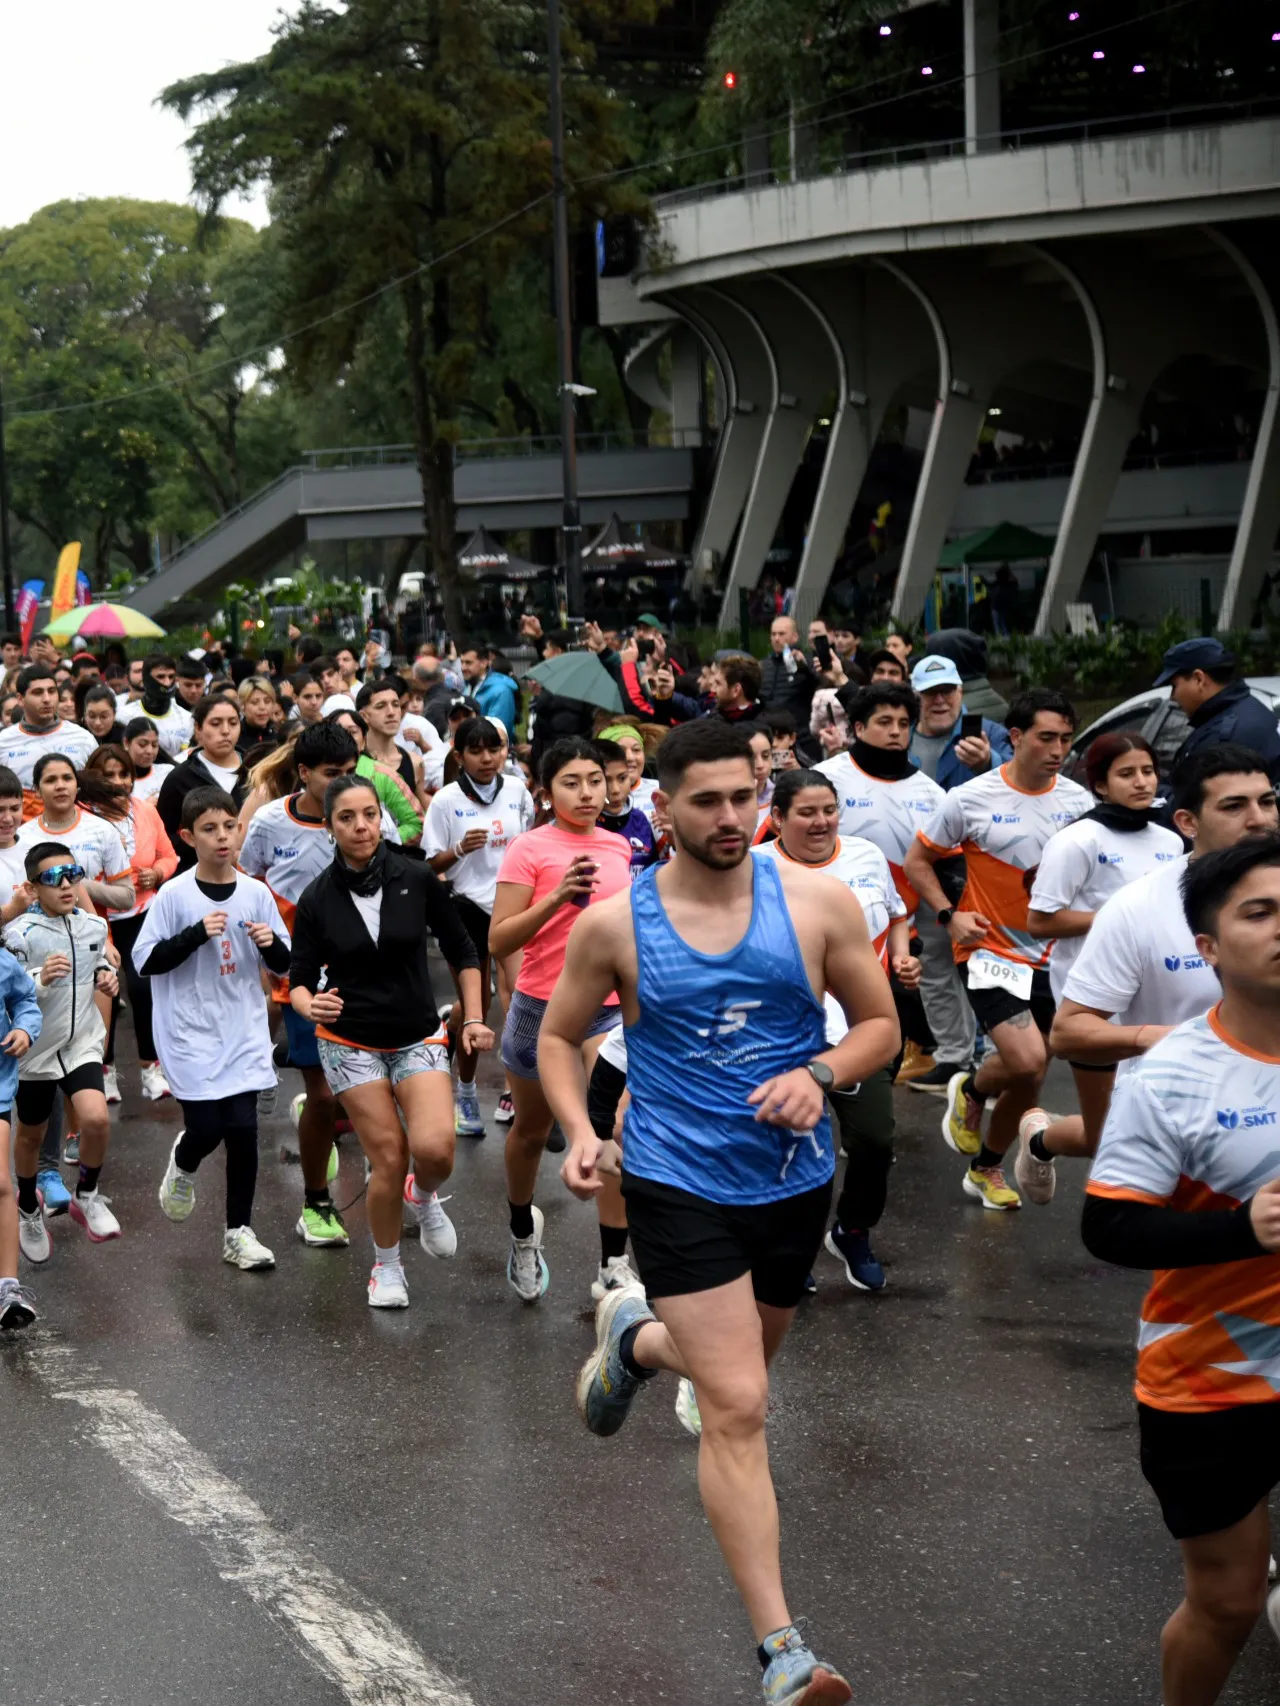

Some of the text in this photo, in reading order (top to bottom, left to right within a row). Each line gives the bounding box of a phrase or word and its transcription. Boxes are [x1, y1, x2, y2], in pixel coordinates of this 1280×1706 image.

[492, 819, 504, 835] 3
[221, 940, 231, 960] 3
[1244, 1111, 1277, 1127] SMT
